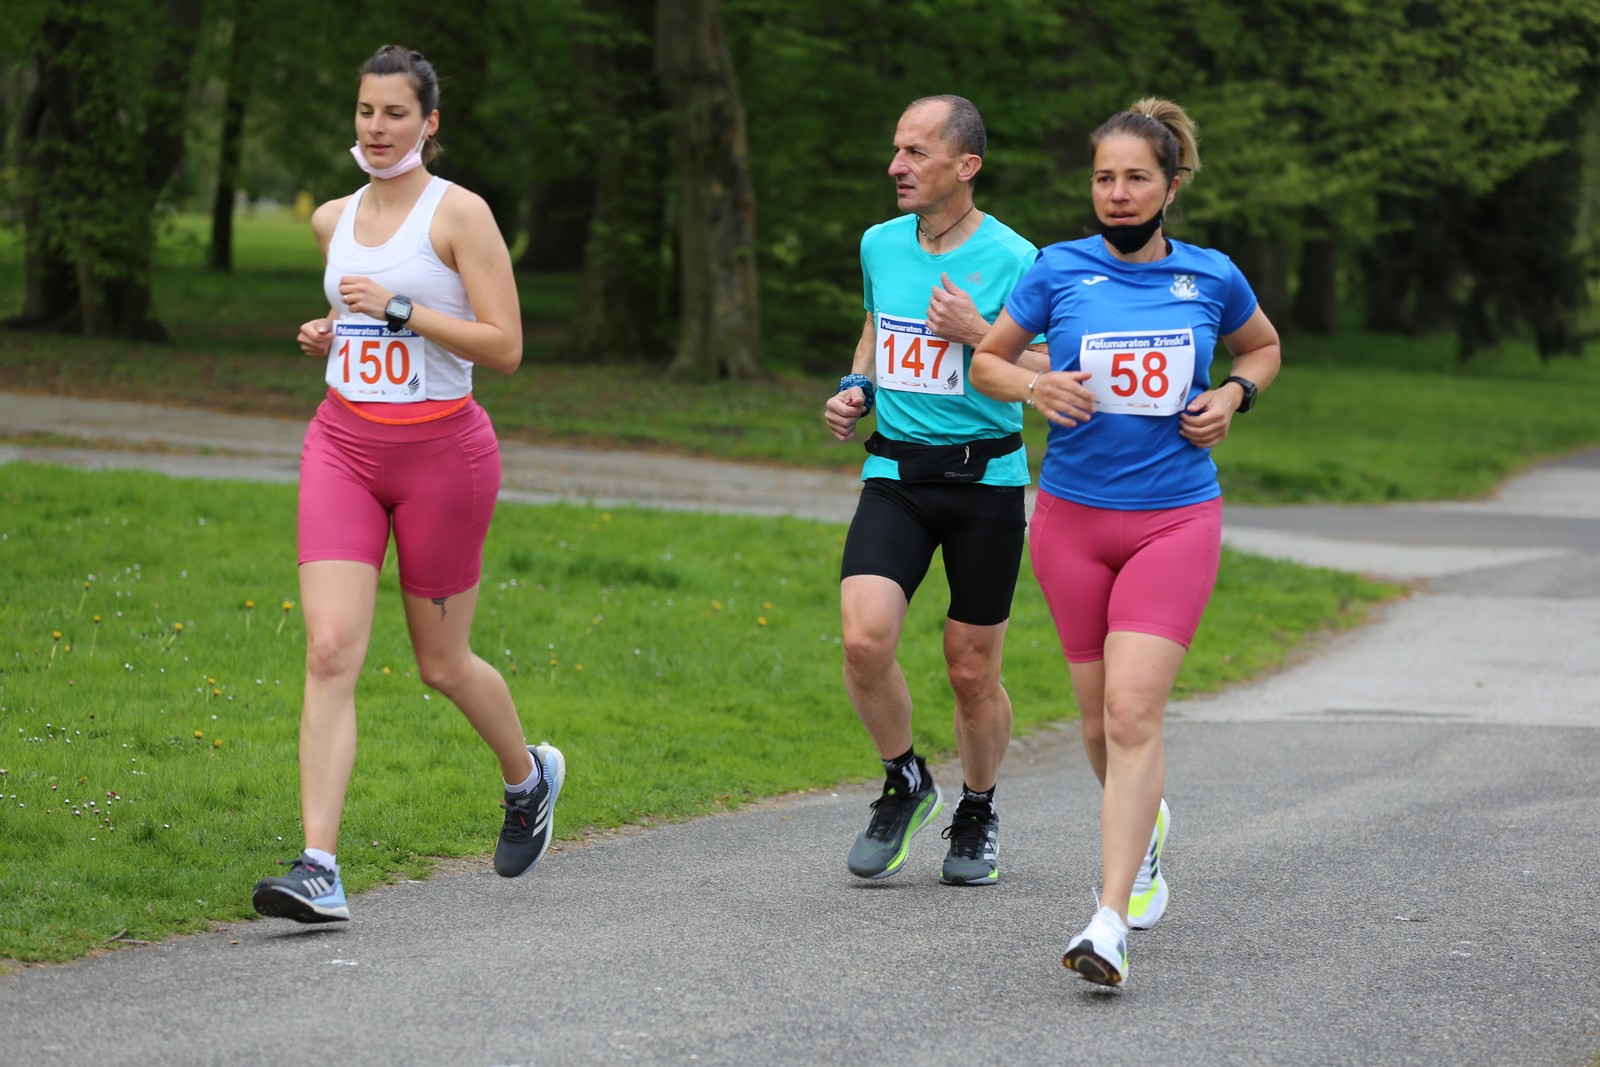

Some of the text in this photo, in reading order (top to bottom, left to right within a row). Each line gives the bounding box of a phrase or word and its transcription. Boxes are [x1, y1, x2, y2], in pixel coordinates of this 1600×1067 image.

[882, 319, 923, 334] Polumaraton
[1088, 339, 1150, 349] Polumaraton
[1153, 335, 1184, 347] Zrinski
[338, 339, 410, 385] 150
[883, 333, 950, 380] 147
[1110, 351, 1169, 398] 58
